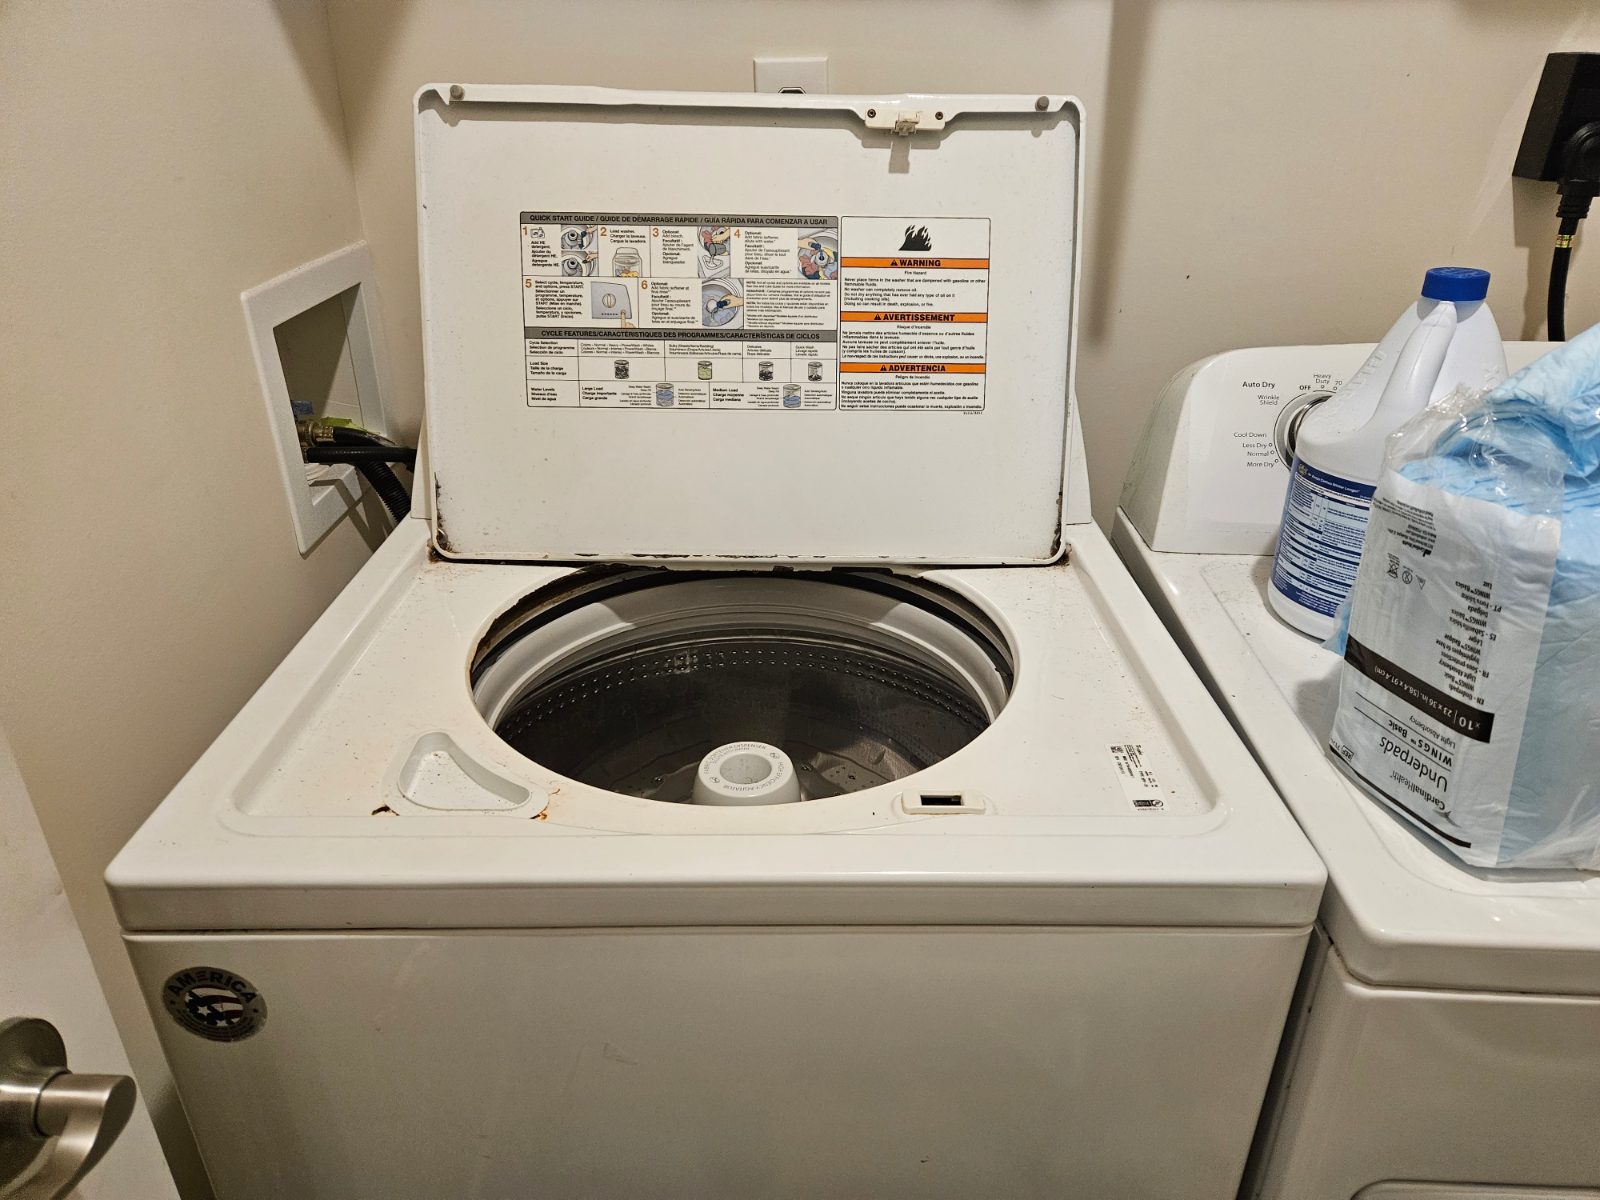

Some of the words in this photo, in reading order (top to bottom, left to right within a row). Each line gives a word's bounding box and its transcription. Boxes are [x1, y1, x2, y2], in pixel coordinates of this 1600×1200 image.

[523, 226, 527, 235] 1
[600, 227, 607, 236] 2
[653, 228, 659, 237] 3
[734, 229, 740, 238] 4
[525, 279, 532, 288] 5
[641, 280, 648, 289] 6
[1374, 666, 1386, 676] cm)
[1385, 673, 1399, 686] 91.4
[1464, 672, 1476, 683] Light
[1404, 685, 1420, 698] (58.4
[1449, 684, 1472, 700] Underpads
[1420, 693, 1429, 702] in.
[1429, 699, 1438, 708] 36
[1388, 720, 1407, 738] Basic
[1409, 715, 1440, 739] Absorbency
[1441, 737, 1456, 749] Light
[1342, 749, 1352, 760] REF
[1380, 737, 1447, 792] Underpads
[168, 970, 258, 1002] AMERICA
